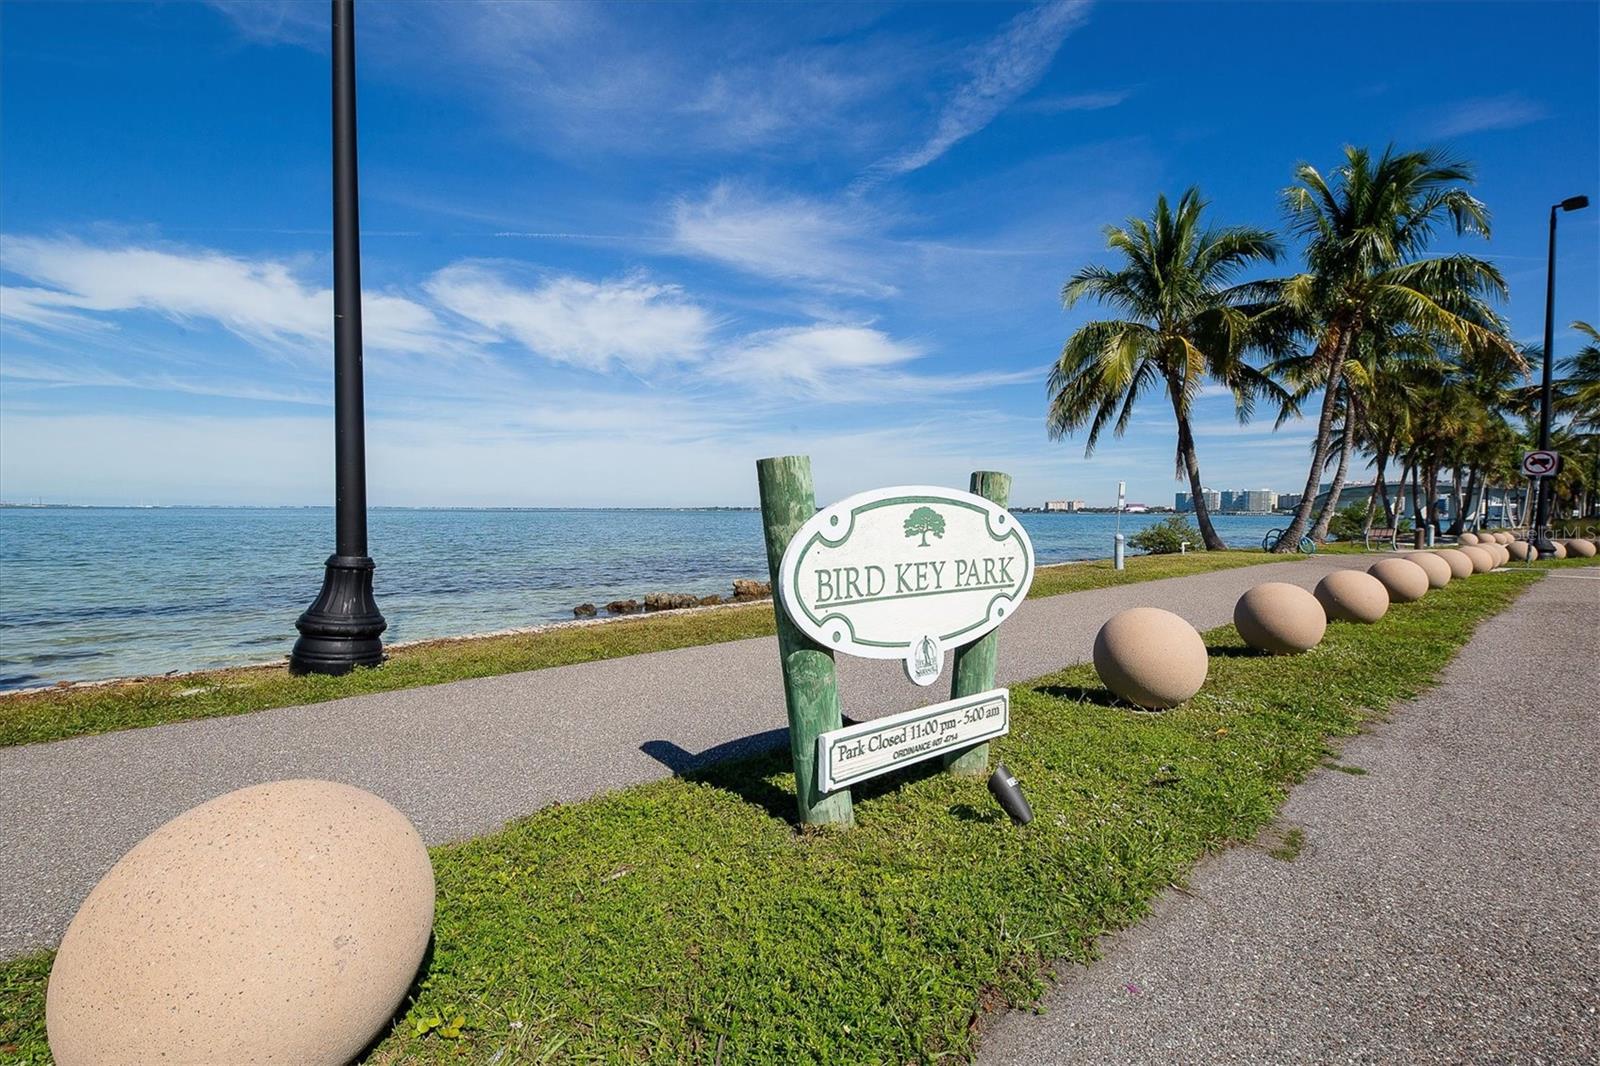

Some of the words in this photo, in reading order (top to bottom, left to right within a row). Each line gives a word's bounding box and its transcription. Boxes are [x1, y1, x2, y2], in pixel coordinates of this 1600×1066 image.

[814, 565, 886, 603] BIRD
[895, 560, 947, 593] KEY
[955, 556, 1015, 587] PARK
[838, 740, 865, 762] Park
[868, 728, 907, 752] Closed
[910, 719, 938, 741] 11:00
[939, 718, 957, 735] pm
[963, 706, 985, 725] 5:00
[985, 706, 1000, 719] am
[892, 743, 931, 759] ORDINANCE
